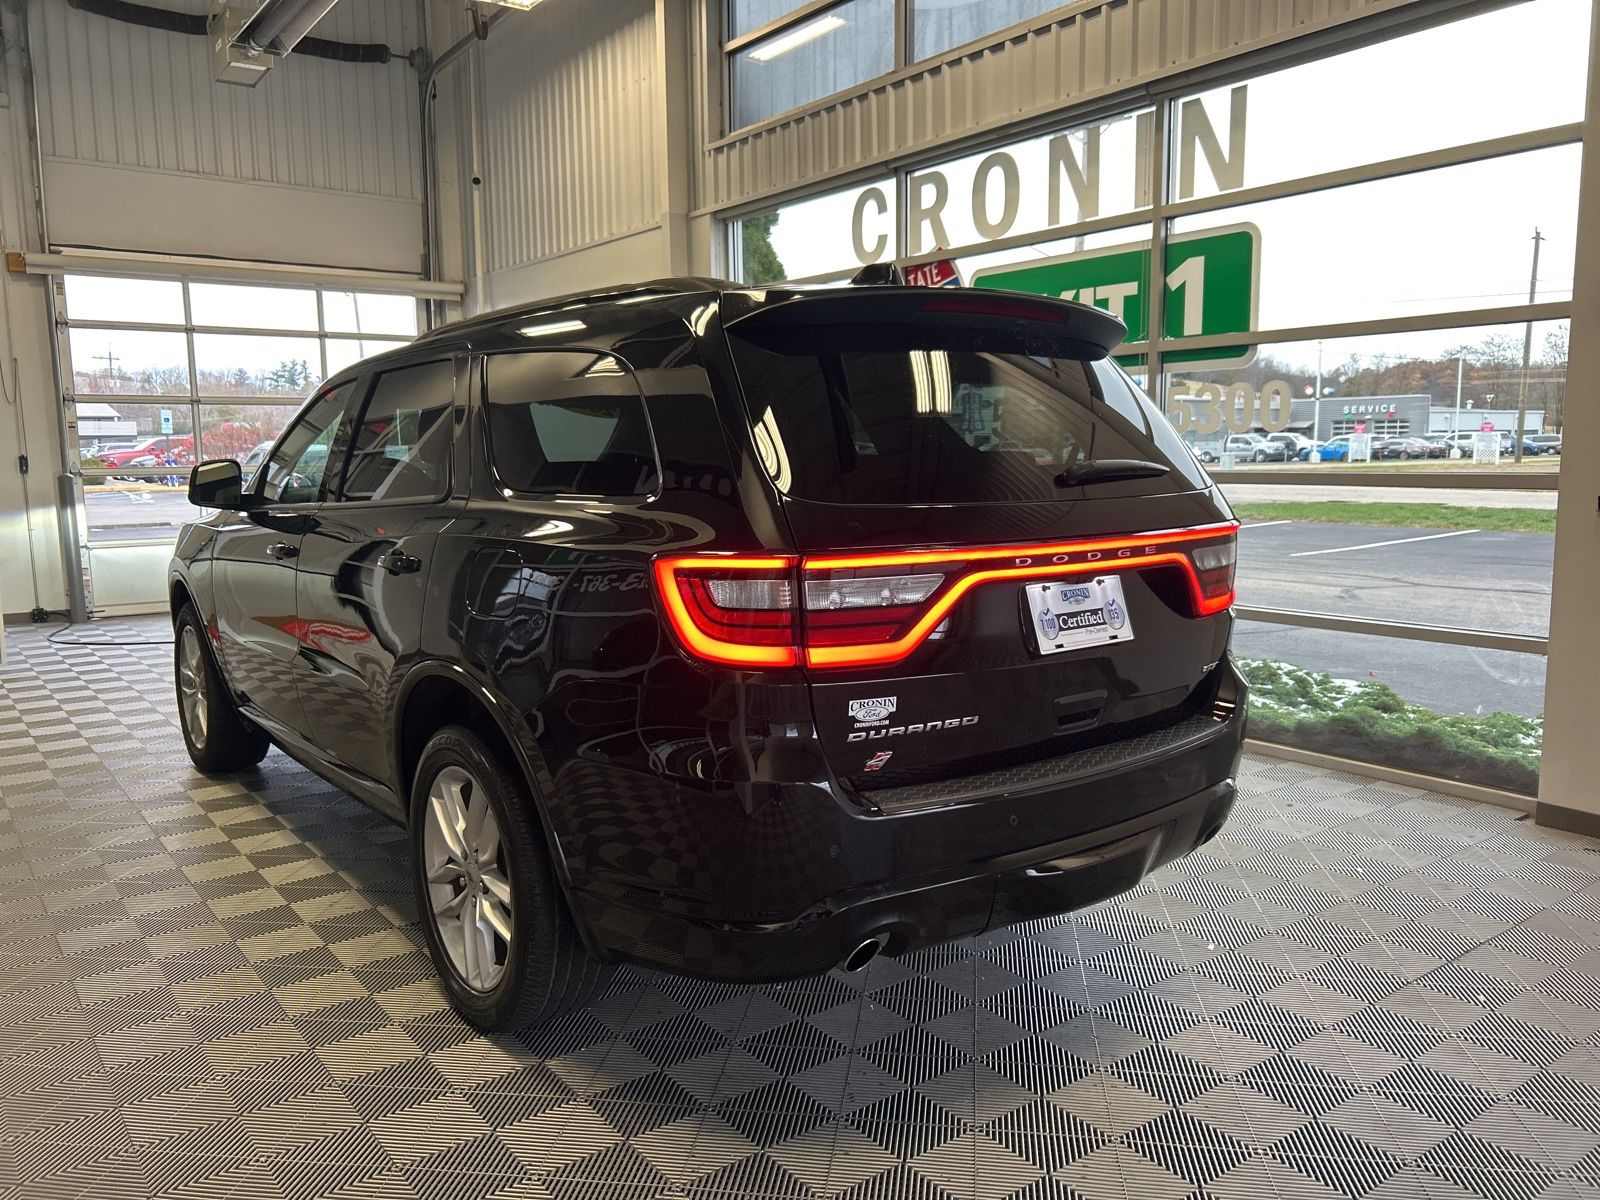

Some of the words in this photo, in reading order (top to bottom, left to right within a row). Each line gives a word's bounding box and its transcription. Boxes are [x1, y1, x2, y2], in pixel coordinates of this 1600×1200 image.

[852, 84, 1248, 265] CRONIN
[1165, 256, 1206, 337] 1
[1167, 380, 1292, 434] 5300
[1343, 403, 1397, 414] SERVICE
[1015, 546, 1157, 567] DODGE
[1062, 587, 1090, 601] CRONIN
[1059, 610, 1104, 629] Certified
[850, 698, 894, 711] CRONIN
[863, 709, 881, 718] Ford
[847, 715, 979, 742] DURANGO
